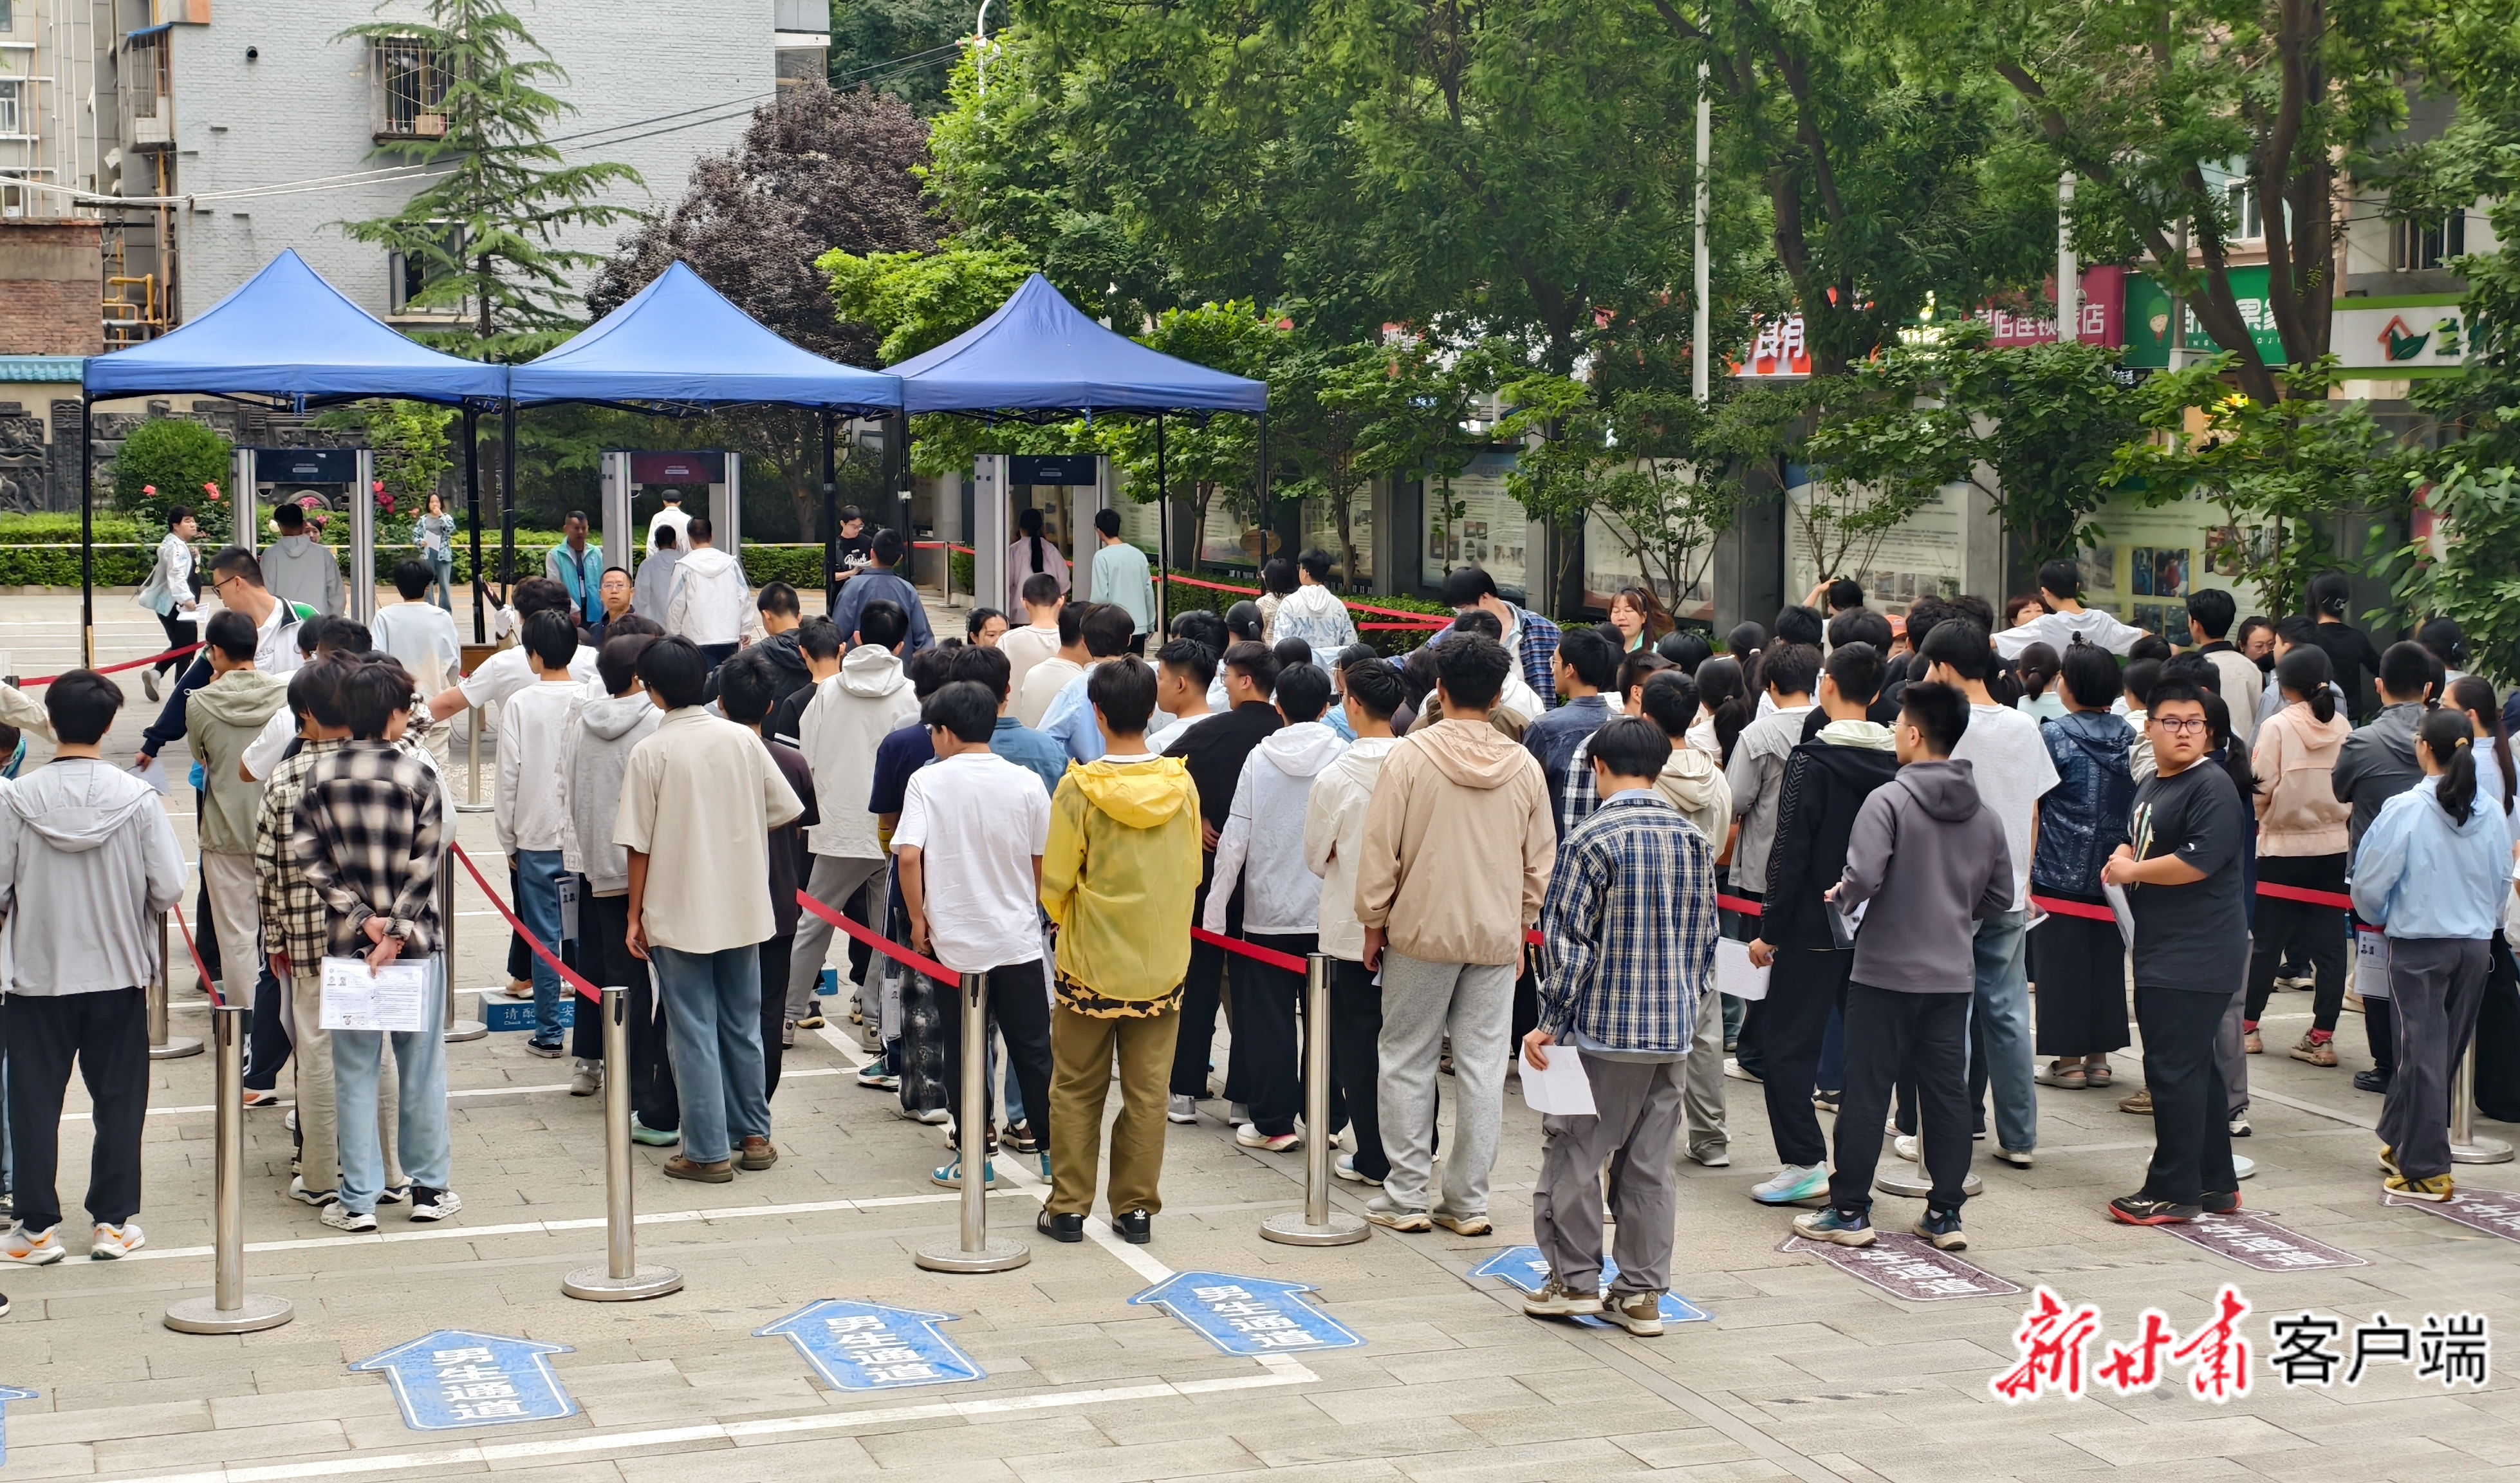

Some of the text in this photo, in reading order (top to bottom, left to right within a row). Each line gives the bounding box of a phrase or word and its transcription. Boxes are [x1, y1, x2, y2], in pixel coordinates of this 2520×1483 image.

[504, 1005, 575, 1020] 请配安
[1842, 1244, 1988, 1294] 生通道
[824, 1314, 944, 1384] 男生通道
[1192, 1285, 1324, 1349] 男生通道
[431, 1346, 530, 1421] 男生通道
